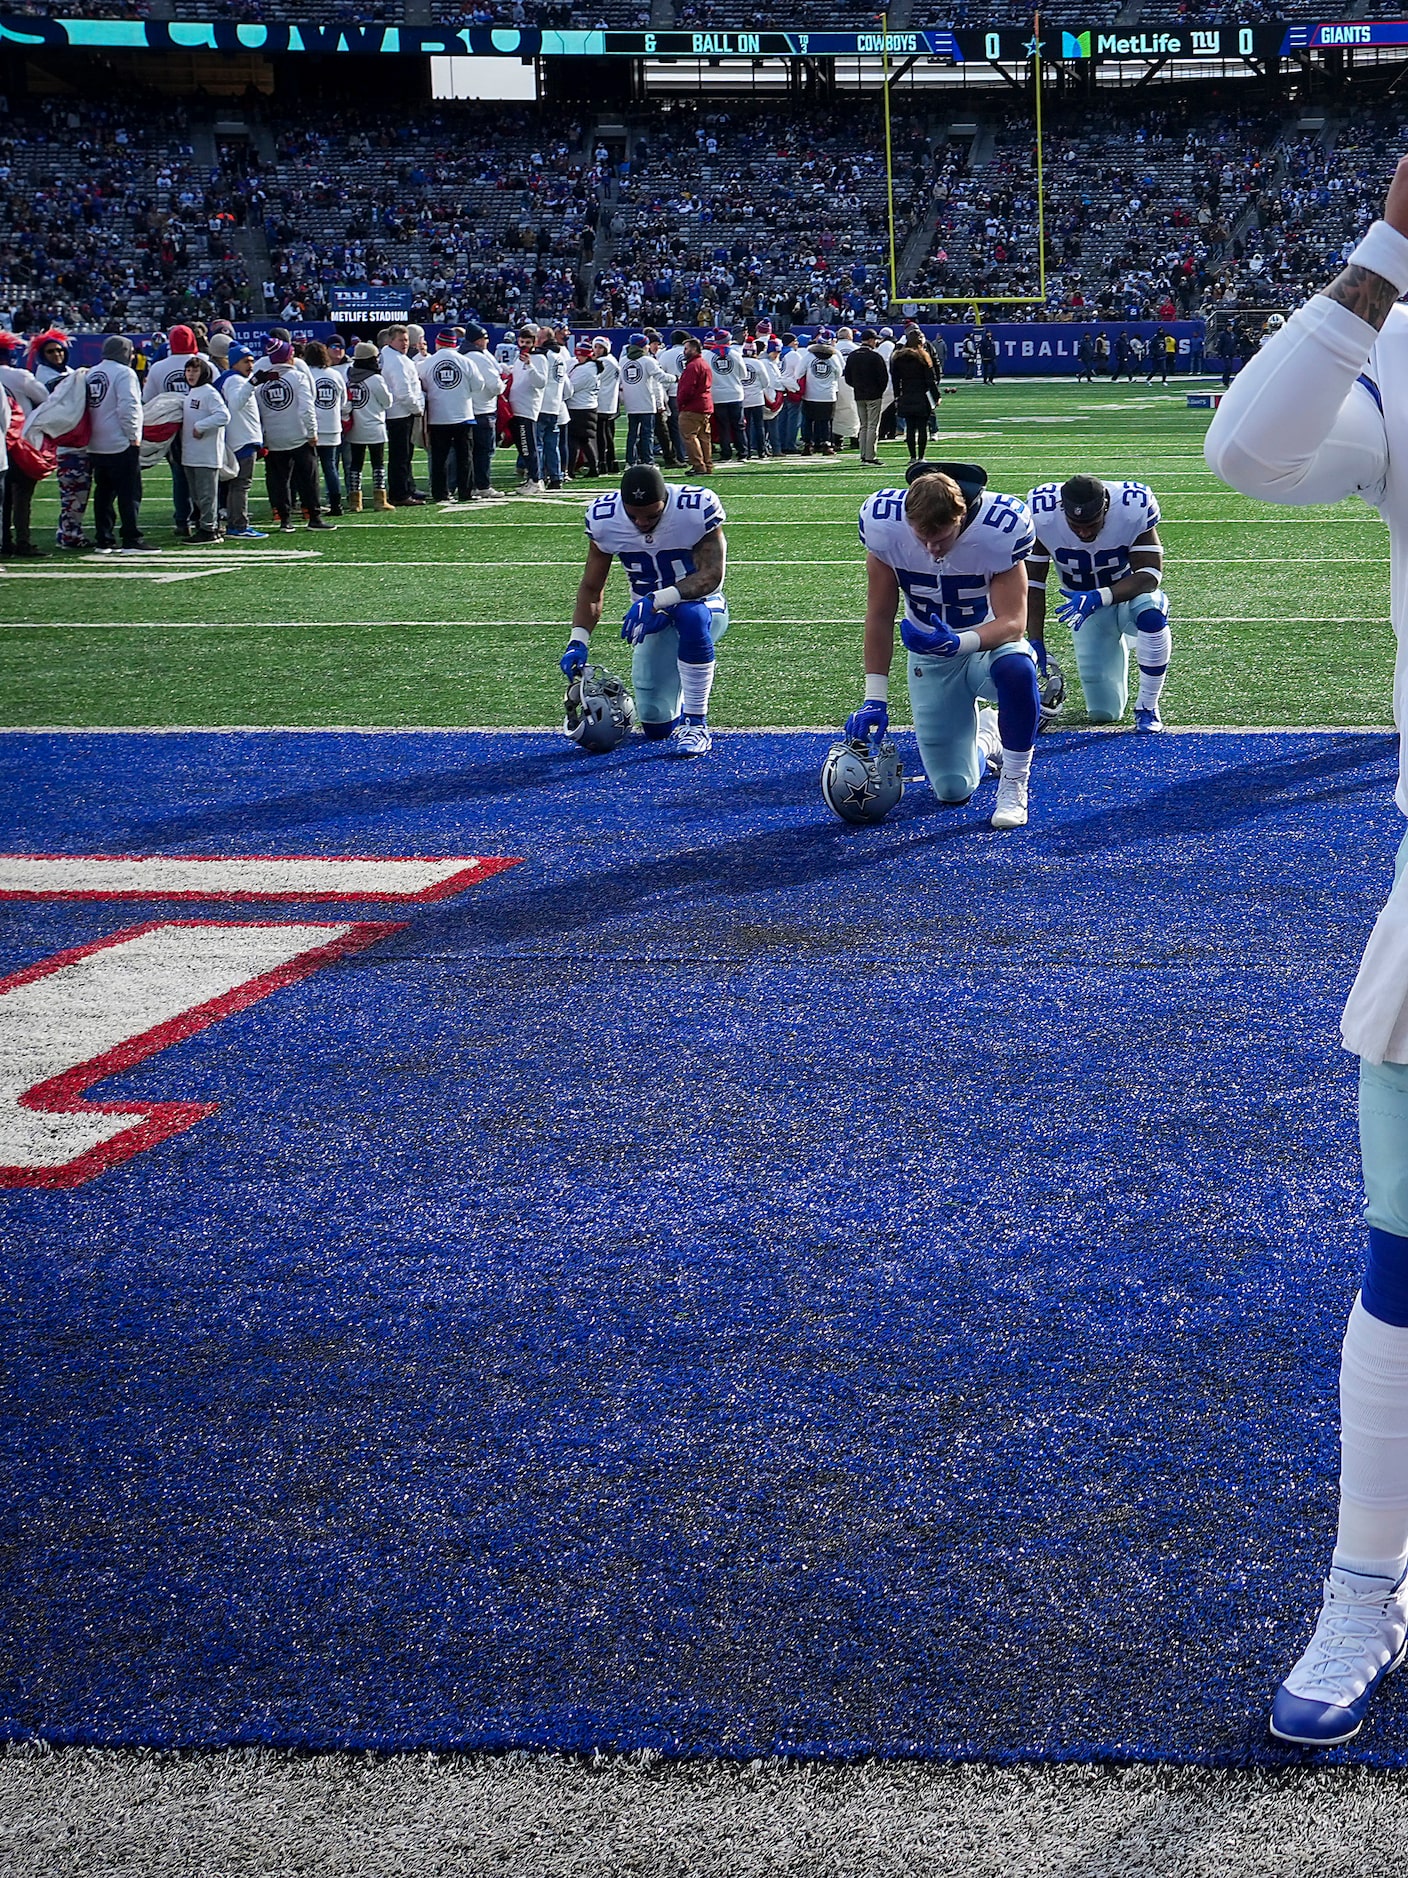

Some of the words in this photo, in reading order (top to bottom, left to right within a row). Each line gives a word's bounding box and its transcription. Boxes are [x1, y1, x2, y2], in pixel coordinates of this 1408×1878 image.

[645, 34, 656, 52] &
[693, 34, 732, 52] BALL
[738, 35, 759, 52] ON
[799, 35, 808, 43] TO
[857, 34, 916, 51] COWBOYS
[1239, 29, 1253, 55] 0
[1321, 25, 1371, 43] GIANTS
[985, 33, 1000, 59] 0
[1098, 34, 1181, 53] MetLife
[331, 311, 368, 322] METLIFE
[370, 311, 408, 322] STADIUM
[617, 548, 698, 597] 20
[1054, 545, 1133, 591] 32
